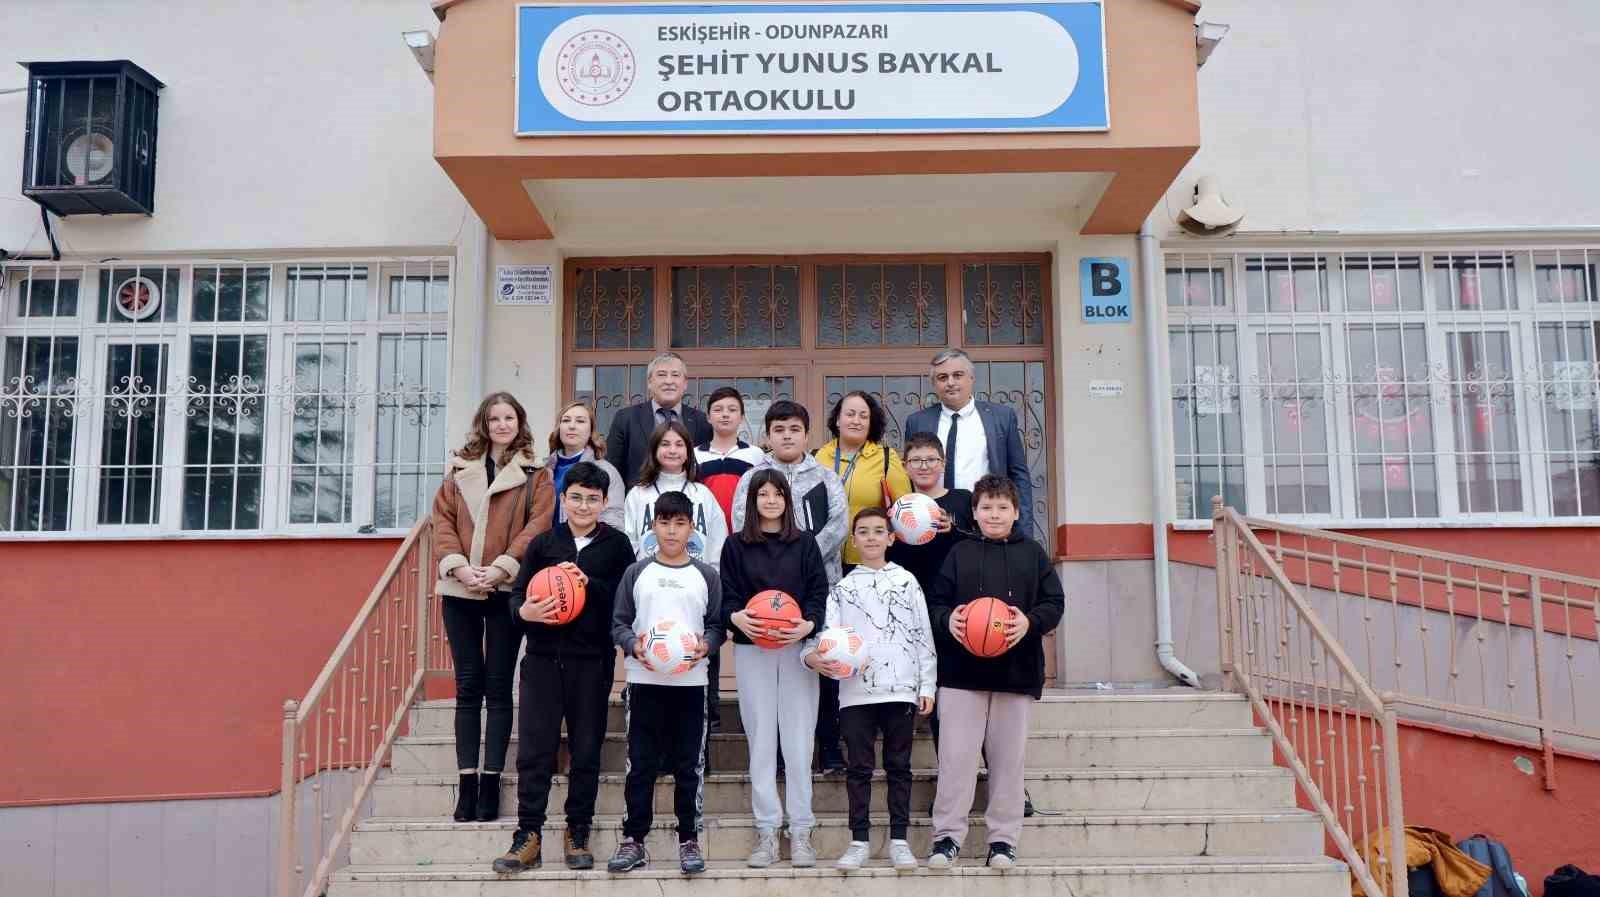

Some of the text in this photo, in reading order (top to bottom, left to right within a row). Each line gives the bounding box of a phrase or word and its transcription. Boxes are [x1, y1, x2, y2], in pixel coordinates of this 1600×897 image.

[658, 23, 750, 44] ESKİŞEHİR
[766, 24, 888, 40] ODUNPAZARI
[658, 50, 1003, 80] ŞEHİT YUNUS BAYKAL
[657, 89, 855, 112] ORTAOKULU
[1090, 262, 1122, 297] B
[1085, 305, 1129, 318] BLOK
[554, 575, 569, 612] avessa
